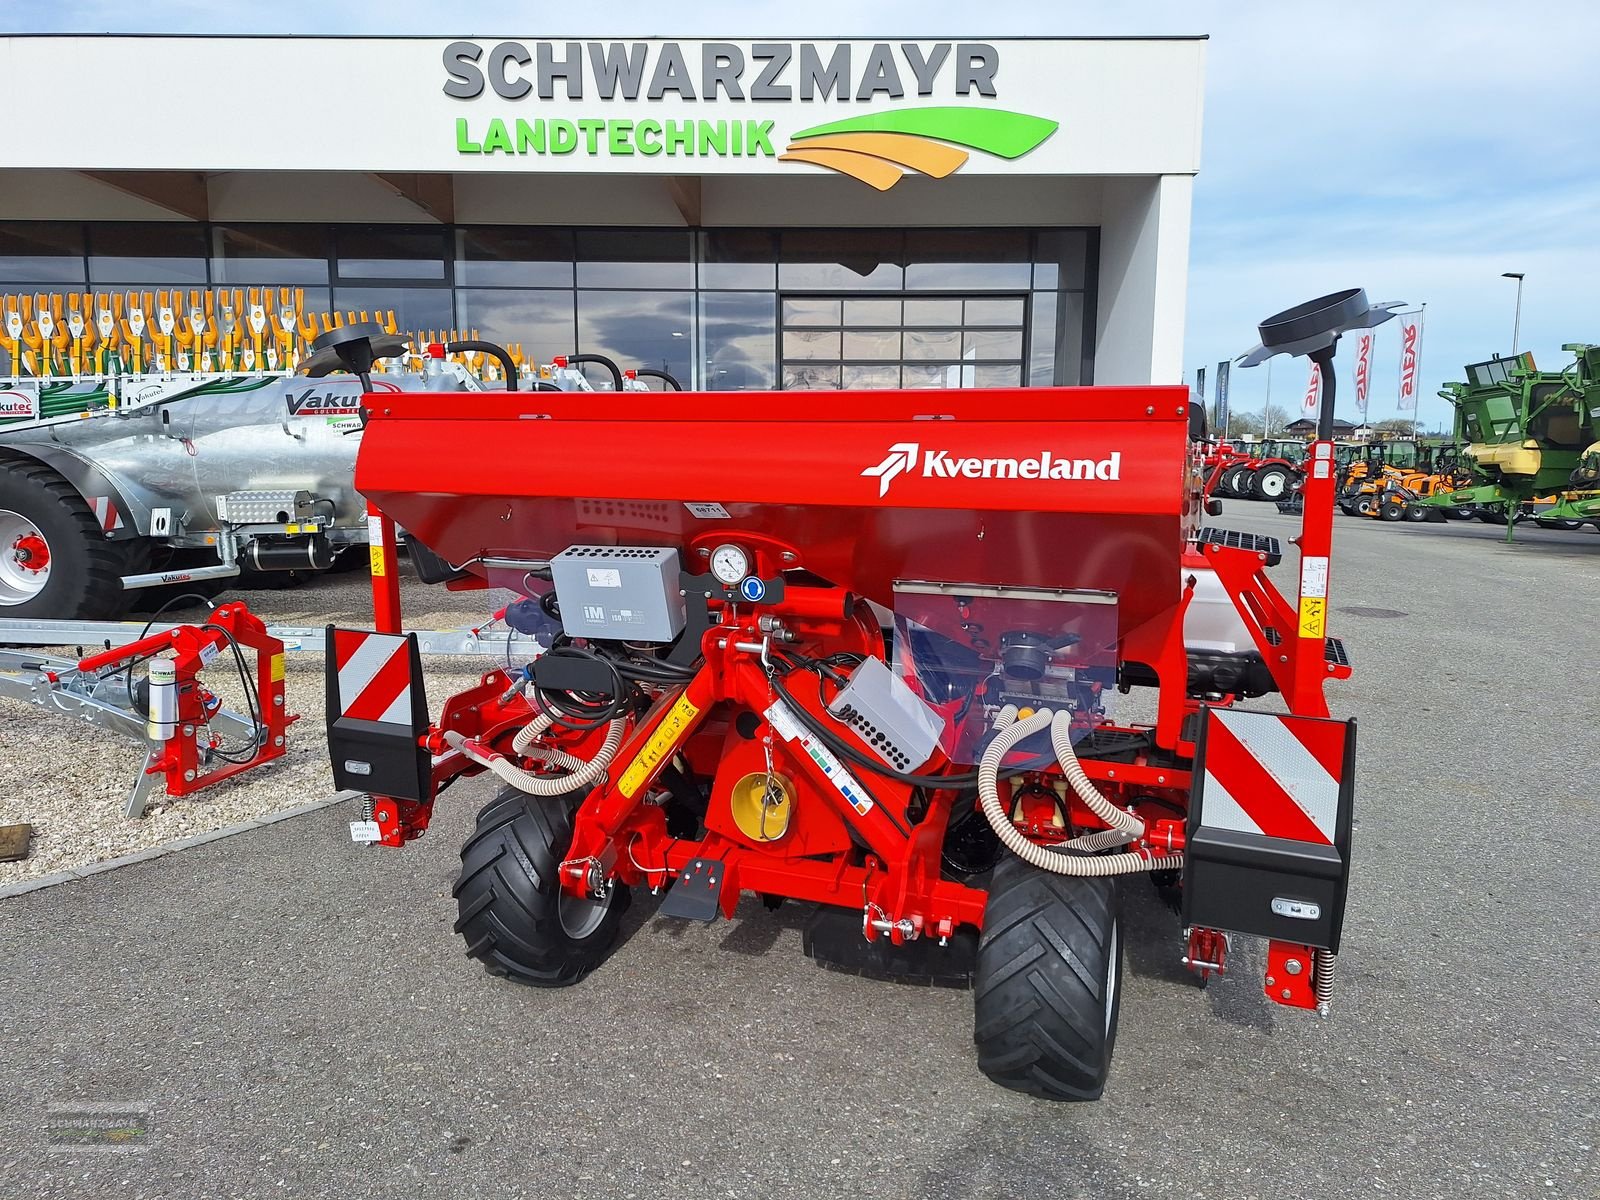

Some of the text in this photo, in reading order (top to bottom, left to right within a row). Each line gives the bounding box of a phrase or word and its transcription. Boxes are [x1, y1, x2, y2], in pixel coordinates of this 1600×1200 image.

[442, 41, 999, 101] SCHWARZMAYR
[456, 117, 775, 156] LANDTECHNIK
[922, 450, 1121, 480] Kverneland
